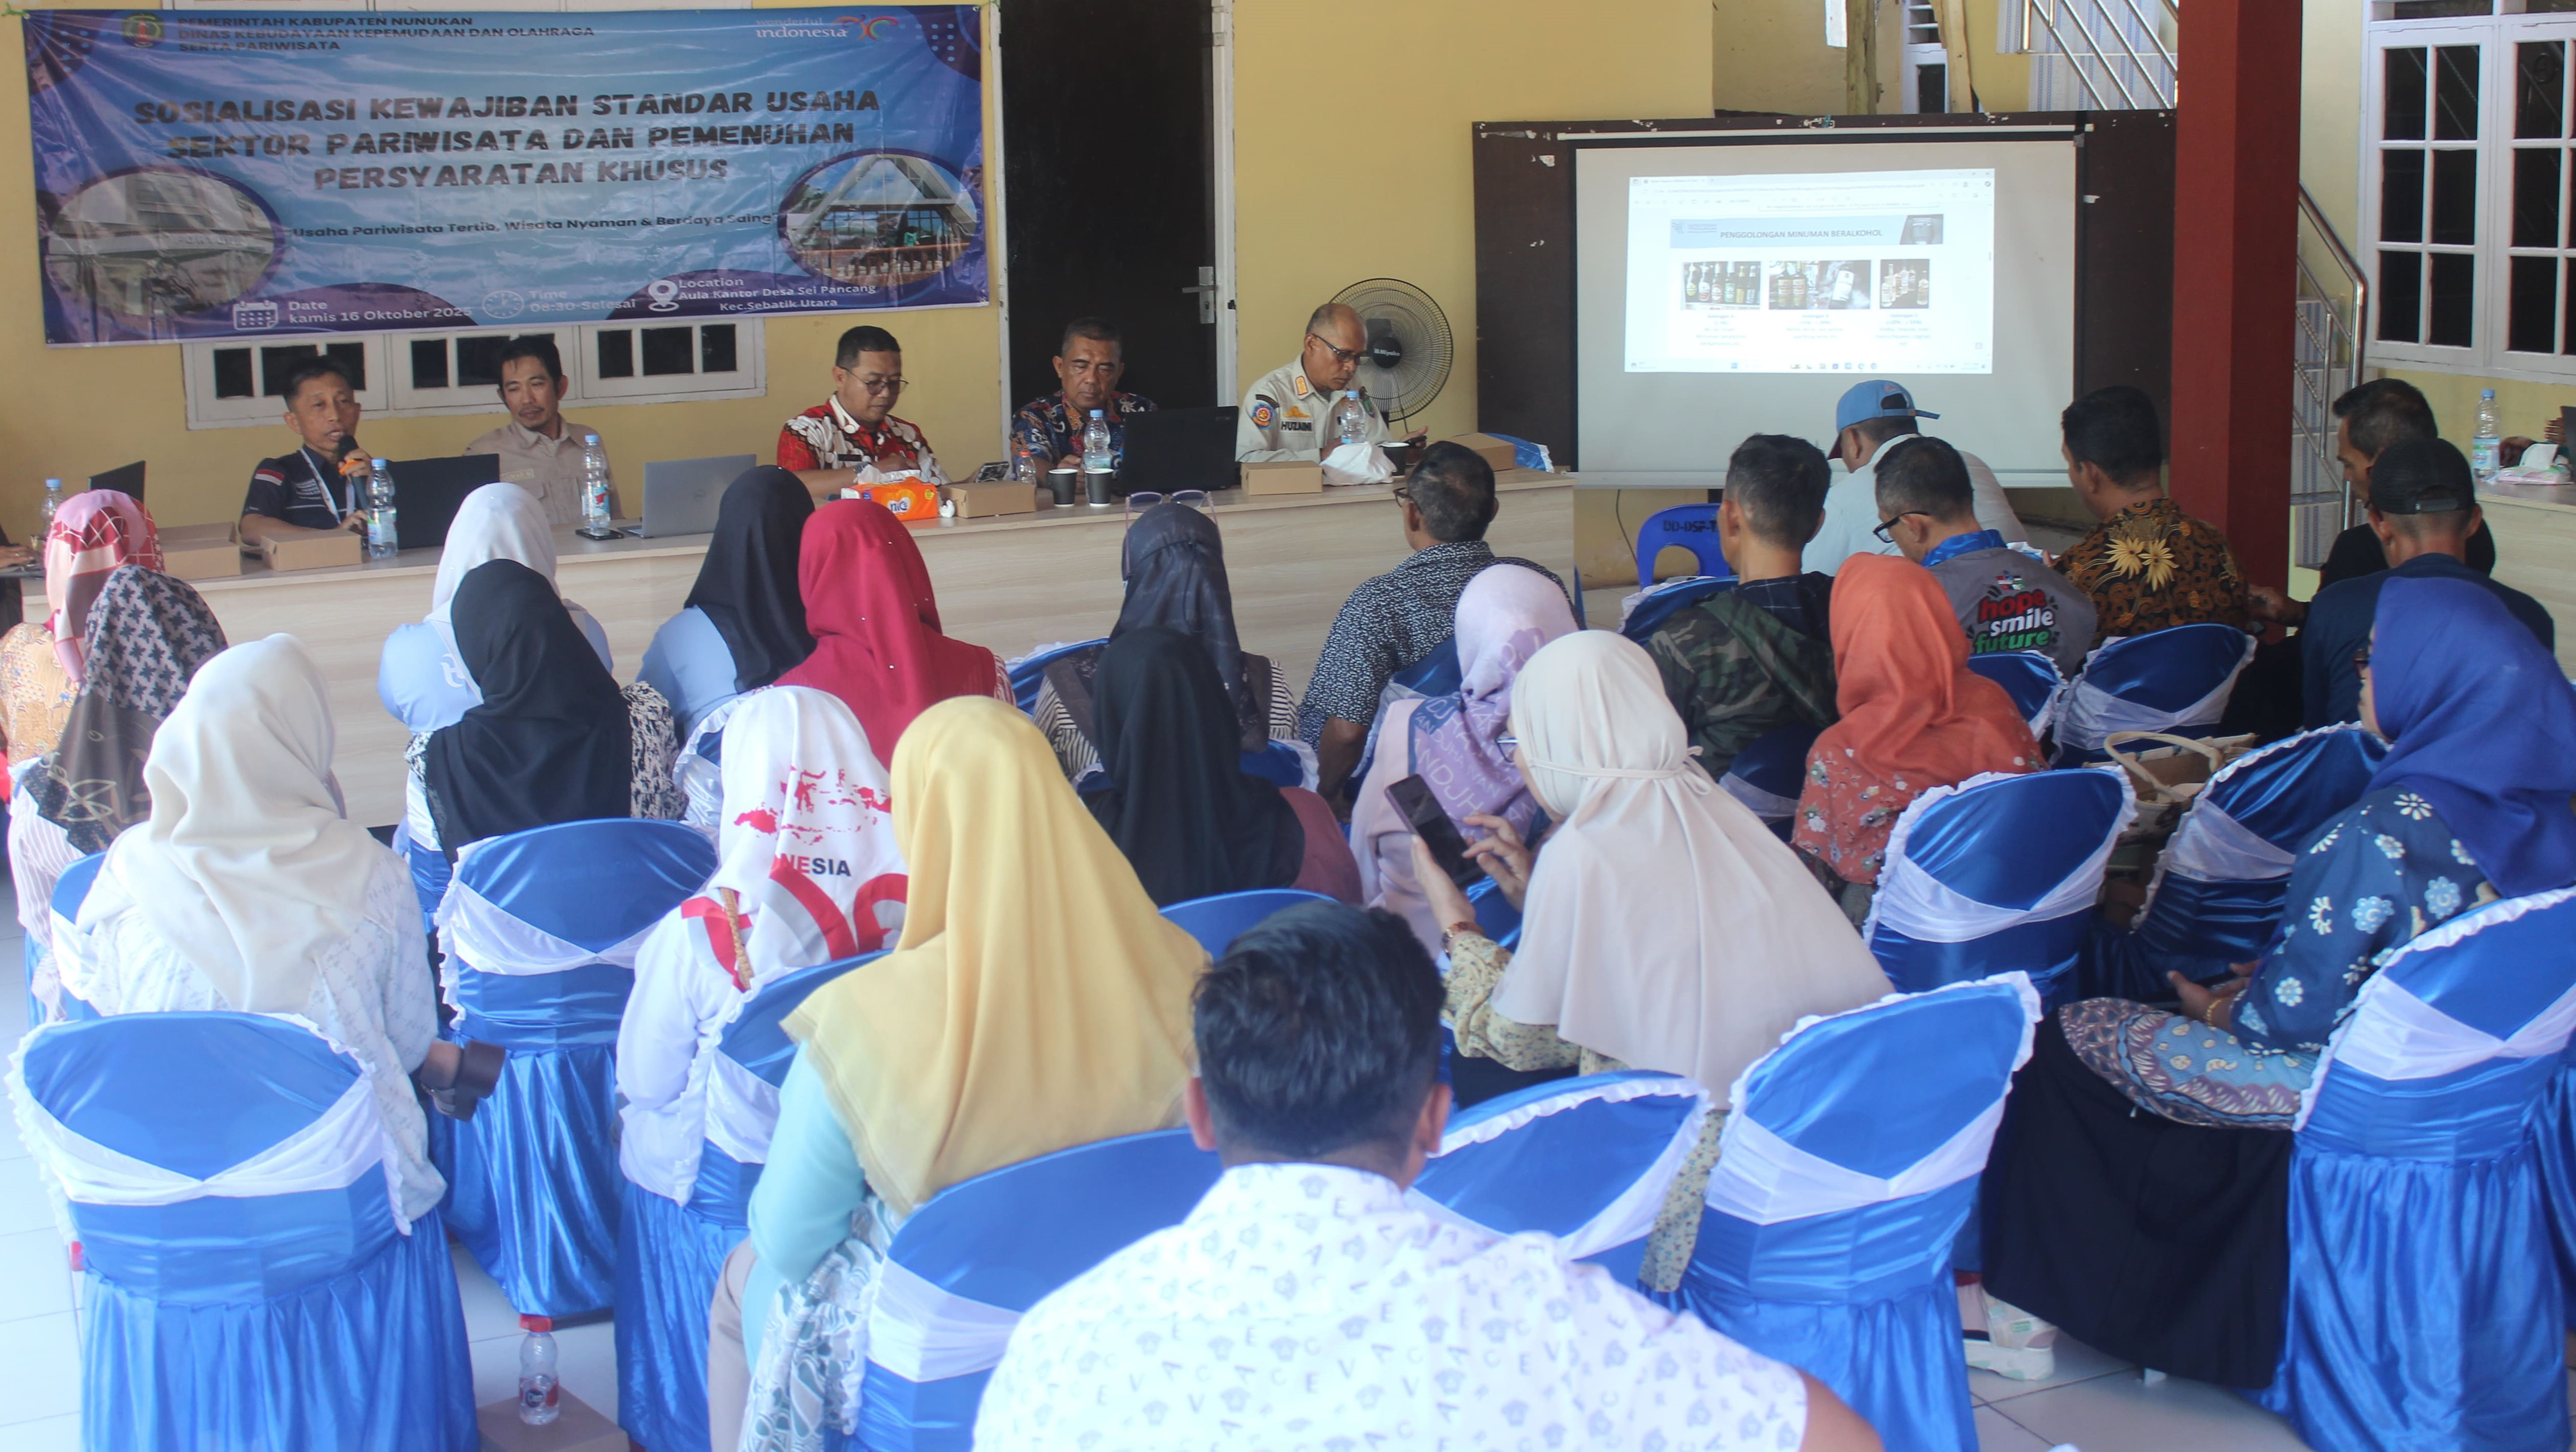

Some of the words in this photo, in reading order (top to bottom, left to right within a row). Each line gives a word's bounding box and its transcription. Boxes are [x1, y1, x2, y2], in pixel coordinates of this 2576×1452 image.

[177, 17, 285, 27] PEMERINTAH
[289, 17, 387, 26] KABUPATEN
[391, 17, 473, 26] NUNUKAN
[756, 17, 823, 26] wonderful
[178, 29, 230, 39] DINAS
[234, 29, 350, 38] KEBUDAYAAN
[353, 28, 466, 37] KEPEMUDAAN
[469, 28, 504, 37] DAN
[507, 27, 595, 36] OLAHRAGA
[755, 26, 848, 38] indonesia
[179, 42, 232, 52] SERTA
[236, 41, 341, 50] PARIWISATA
[134, 98, 356, 124] SOSIALISASI
[370, 94, 579, 120] KEWAJIBAN
[592, 92, 753, 116] STANDAR
[766, 90, 880, 112] USAHA
[167, 134, 311, 159] SEKTOR
[326, 129, 549, 155] PARIWISATA
[562, 127, 634, 150] DAN
[648, 123, 854, 148] PEMENUHAN
[313, 162, 584, 190] PERSYARATAN
[597, 158, 728, 184] KHUSUS
[352, 224, 444, 236] Pariwisata
[447, 222, 500, 233] Tertib,
[505, 218, 563, 231] Wisata
[567, 217, 637, 230] Nyaman
[641, 217, 652, 226] &
[657, 214, 723, 227] Berdaya
[1720, 231, 1784, 239] PENGGOLONGAN
[1787, 230, 1830, 238] MINUMAN
[1830, 229, 1883, 237] BERALKOHOL
[678, 277, 744, 289] Location
[528, 291, 567, 300] Time
[678, 290, 710, 301] Aula
[712, 289, 758, 300] Kantor
[762, 287, 795, 297] Desa
[797, 286, 817, 295] Sei
[821, 285, 877, 295] Pancang
[288, 301, 328, 311] Date
[800, 298, 838, 308] Utara
[288, 312, 337, 324] kamis
[340, 311, 360, 322] 16
[363, 309, 430, 321] Oktober
[432, 306, 473, 317] 2025
[1979, 589, 2047, 623] hope
[1990, 607, 2054, 637] smile
[1975, 631, 2050, 654] future
